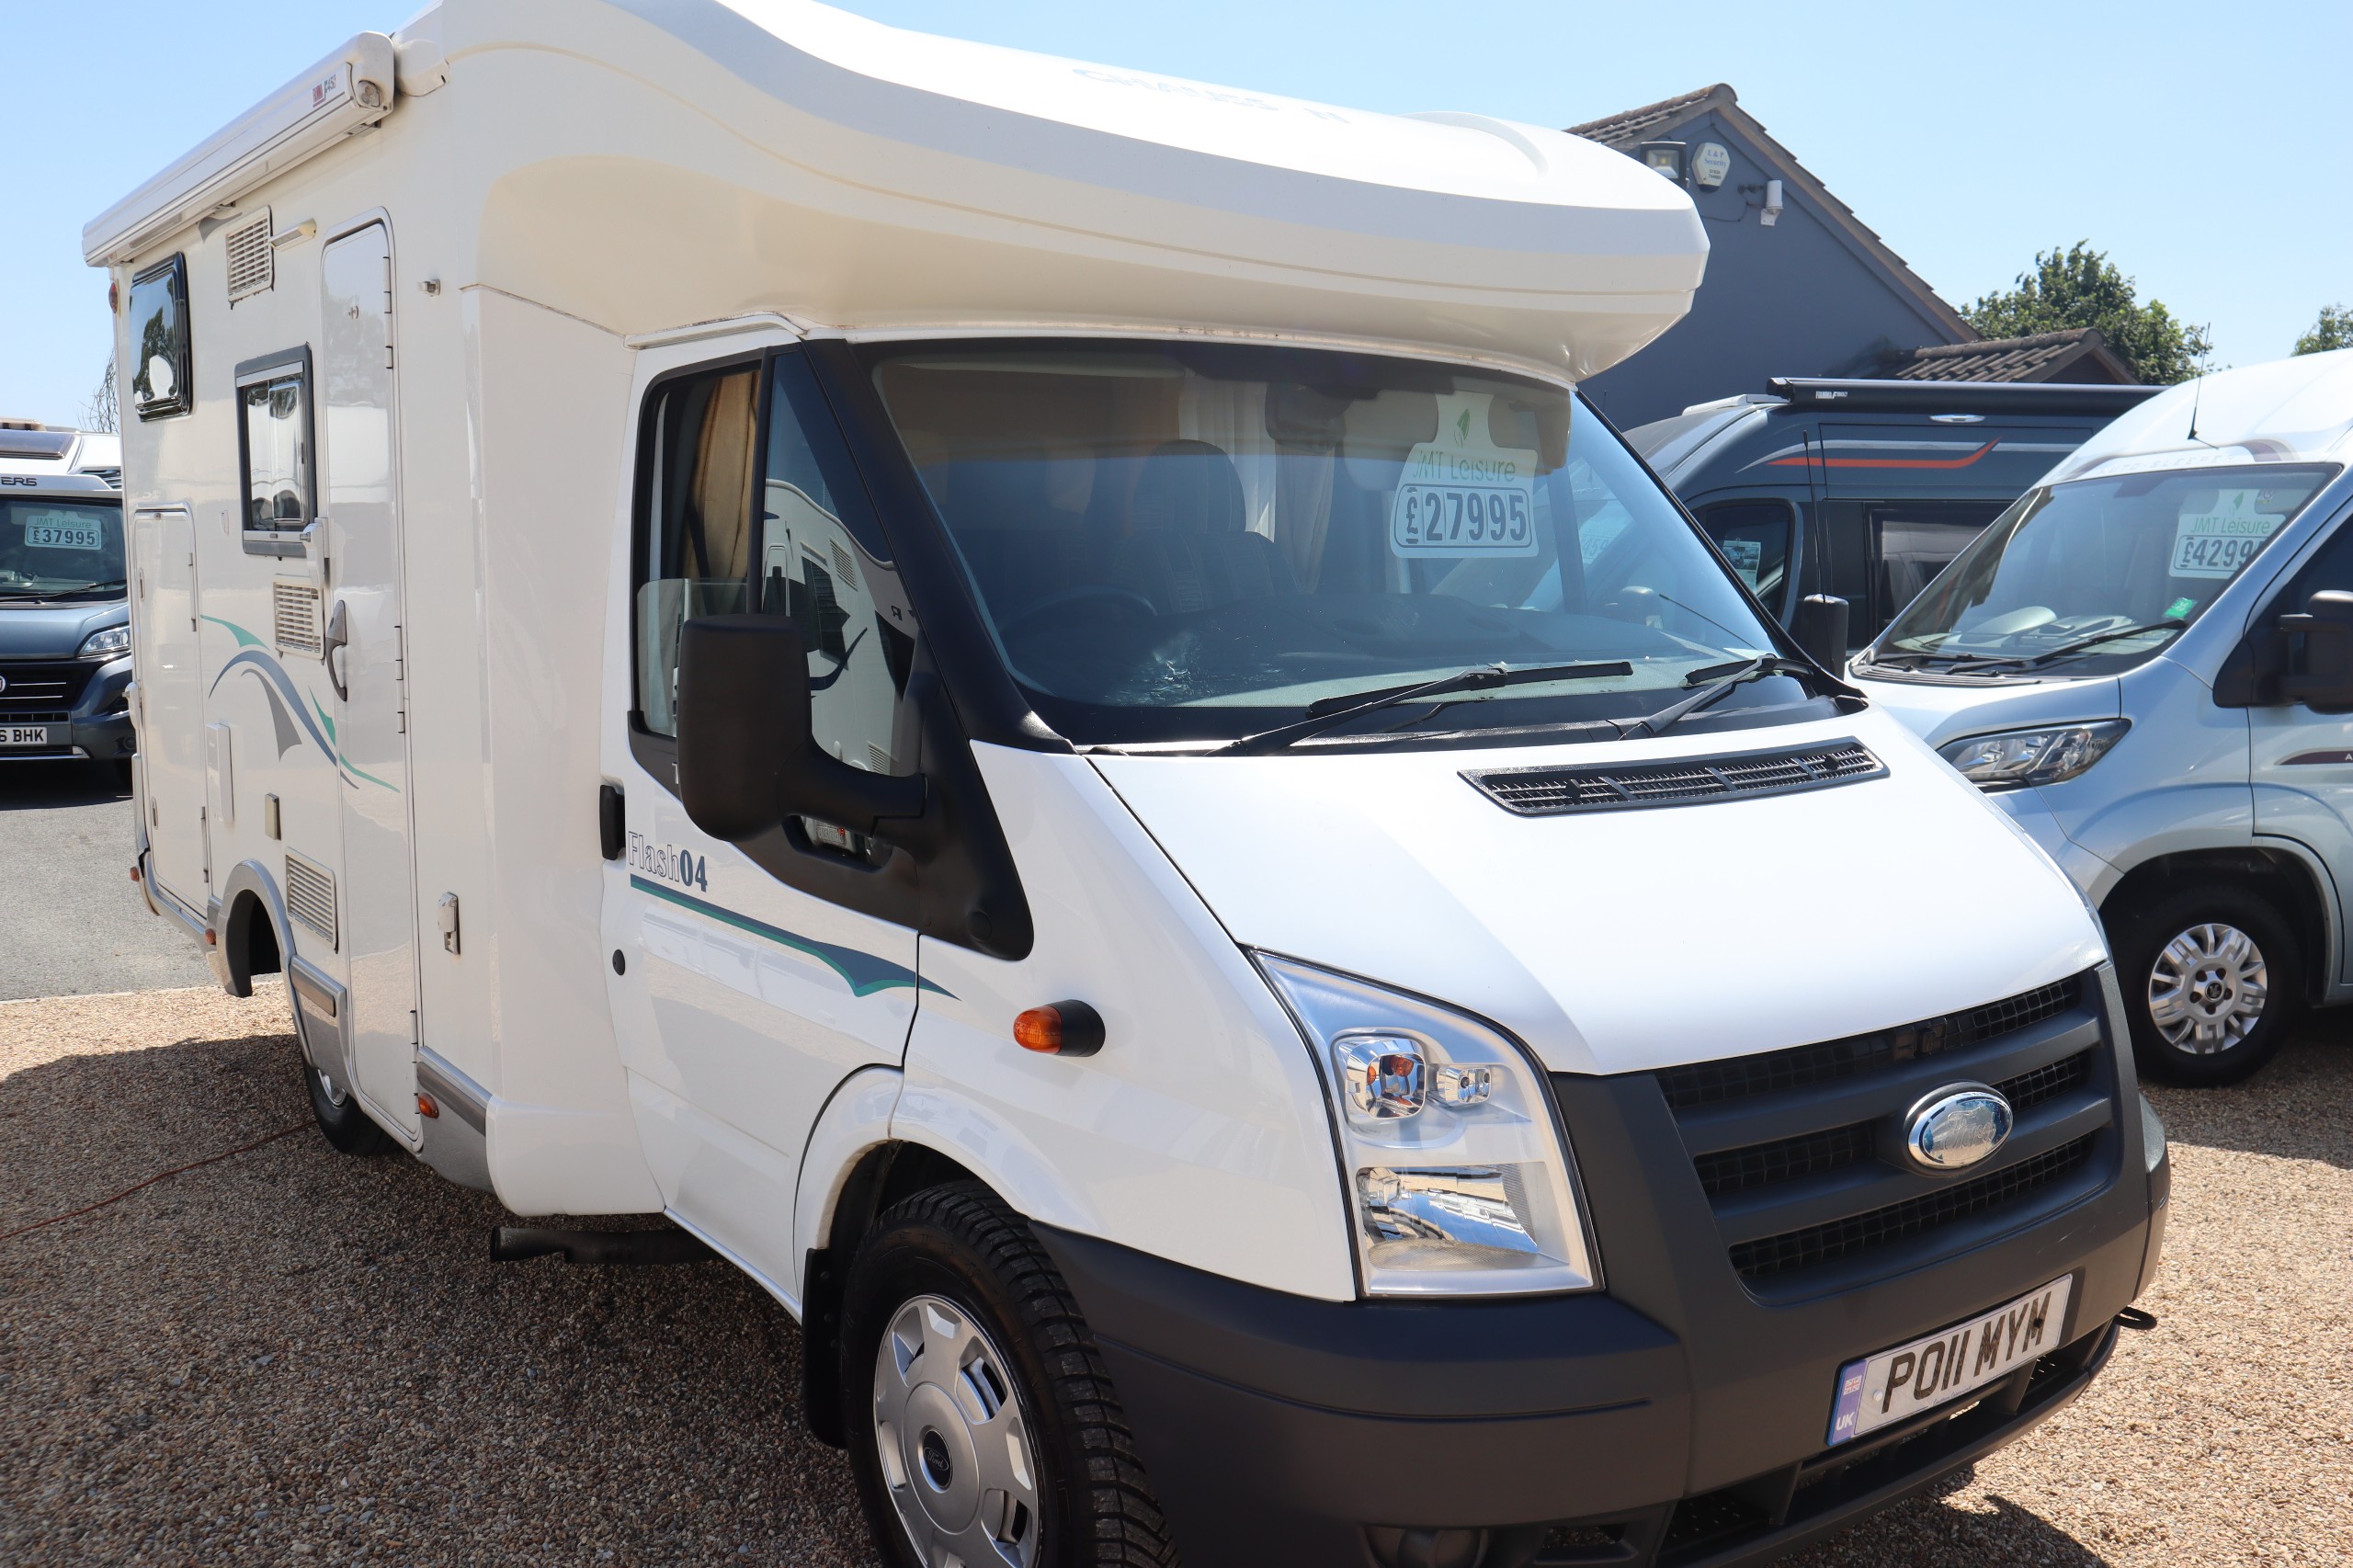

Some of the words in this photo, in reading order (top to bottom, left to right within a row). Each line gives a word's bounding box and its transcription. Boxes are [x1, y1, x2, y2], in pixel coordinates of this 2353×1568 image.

[1414, 449, 1444, 479] JMT
[1450, 456, 1516, 483] Leisure
[35, 517, 53, 527] JMT
[57, 518, 92, 528] Leisure
[1406, 492, 1527, 541] £27995
[2190, 517, 2220, 533] JMT
[2221, 517, 2270, 534] Leisure
[32, 528, 96, 546] £37995
[2182, 539, 2265, 568] £4299
[13, 729, 44, 743] BHK
[1973, 1290, 2052, 1378] MYM
[1836, 1411, 1856, 1431] UK
[927, 1449, 944, 1469] Ford
